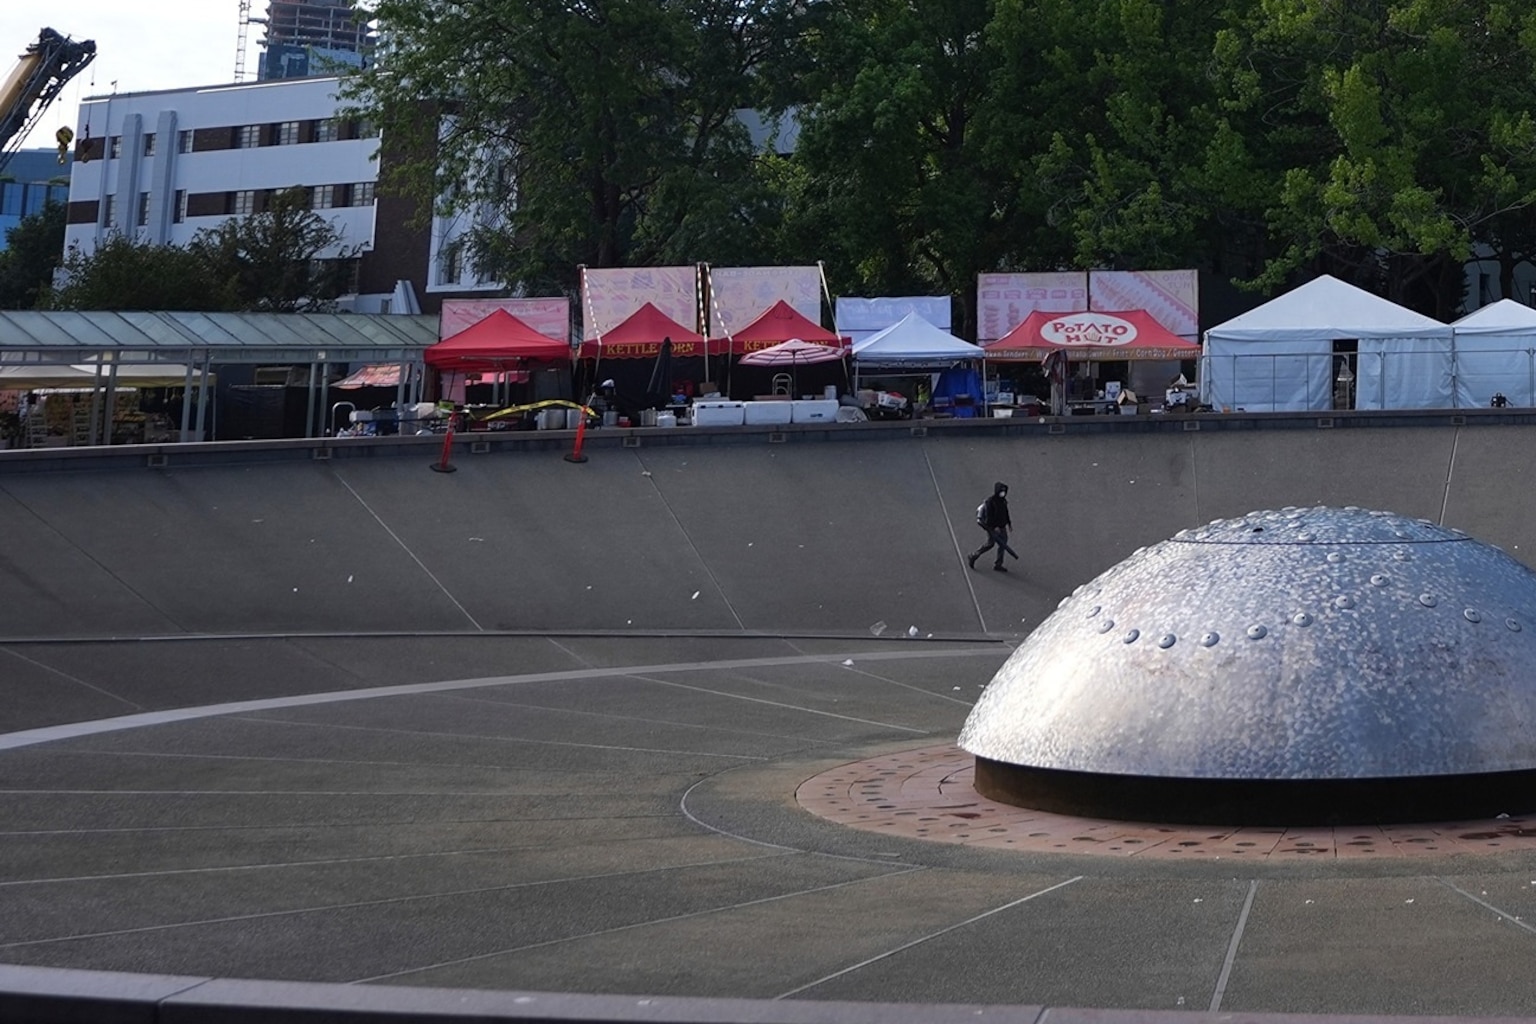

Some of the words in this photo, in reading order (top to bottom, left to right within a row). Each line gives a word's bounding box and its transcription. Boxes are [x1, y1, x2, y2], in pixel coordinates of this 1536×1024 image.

[1053, 322, 1128, 336] POTATO
[1066, 334, 1118, 344] HUT
[607, 343, 657, 355] KETTLE
